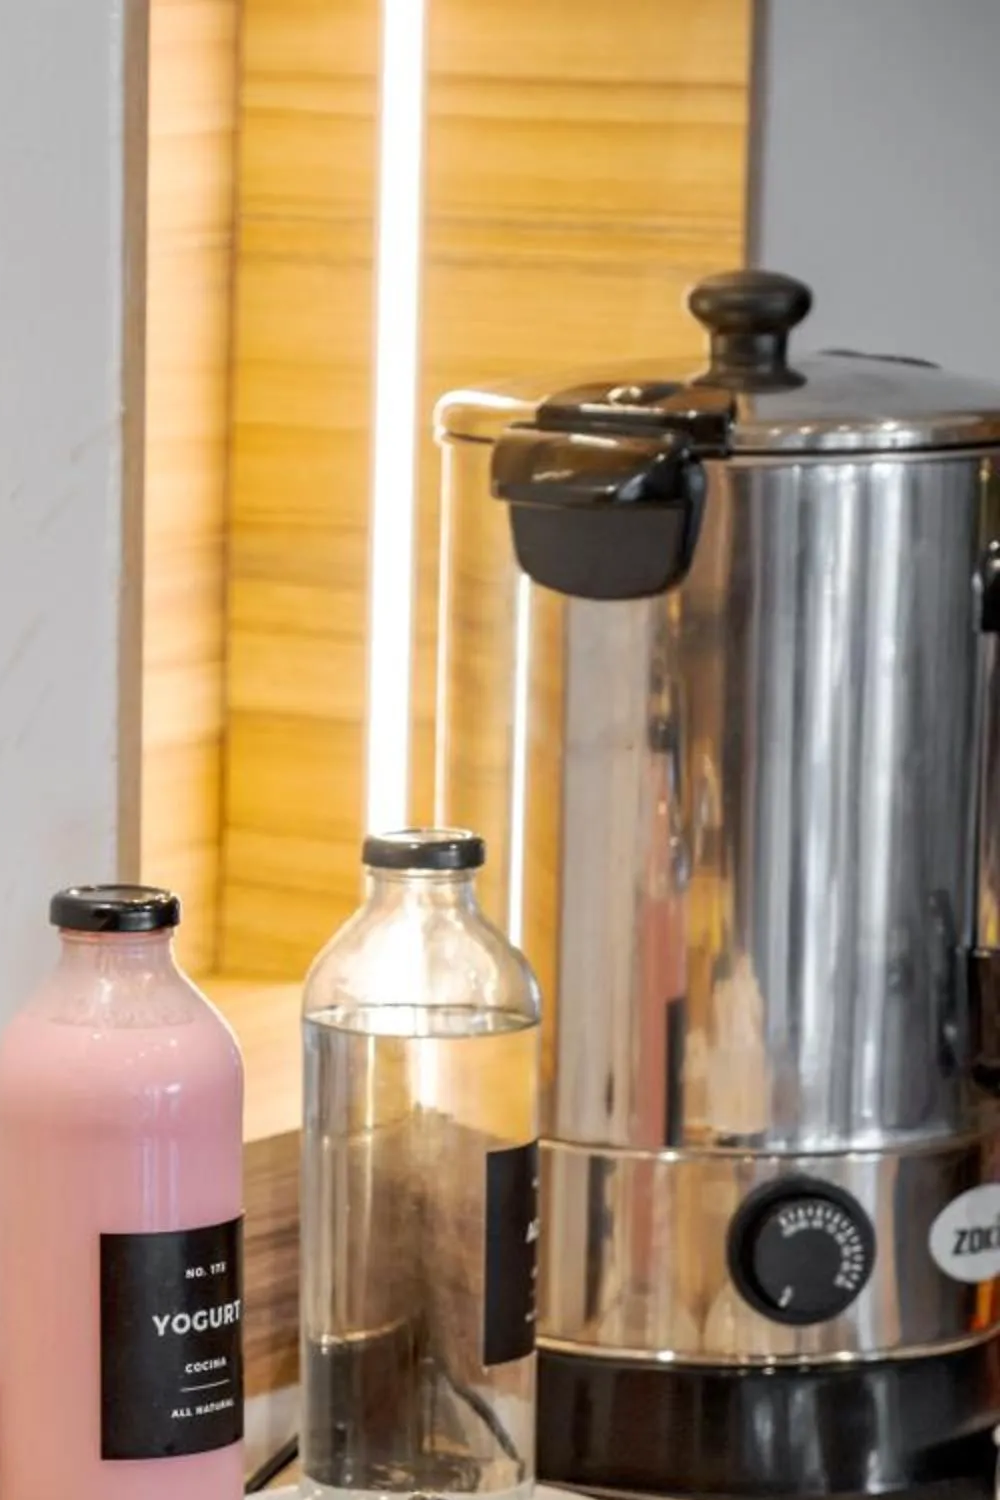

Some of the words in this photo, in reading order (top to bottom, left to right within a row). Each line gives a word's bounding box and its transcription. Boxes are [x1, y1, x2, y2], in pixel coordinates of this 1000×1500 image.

[185, 1266, 206, 1279] NO.
[152, 1299, 241, 1336] YOGURT
[185, 1356, 227, 1374] COCINA
[171, 1407, 193, 1419] ALL
[195, 1399, 234, 1415] NATURAL
